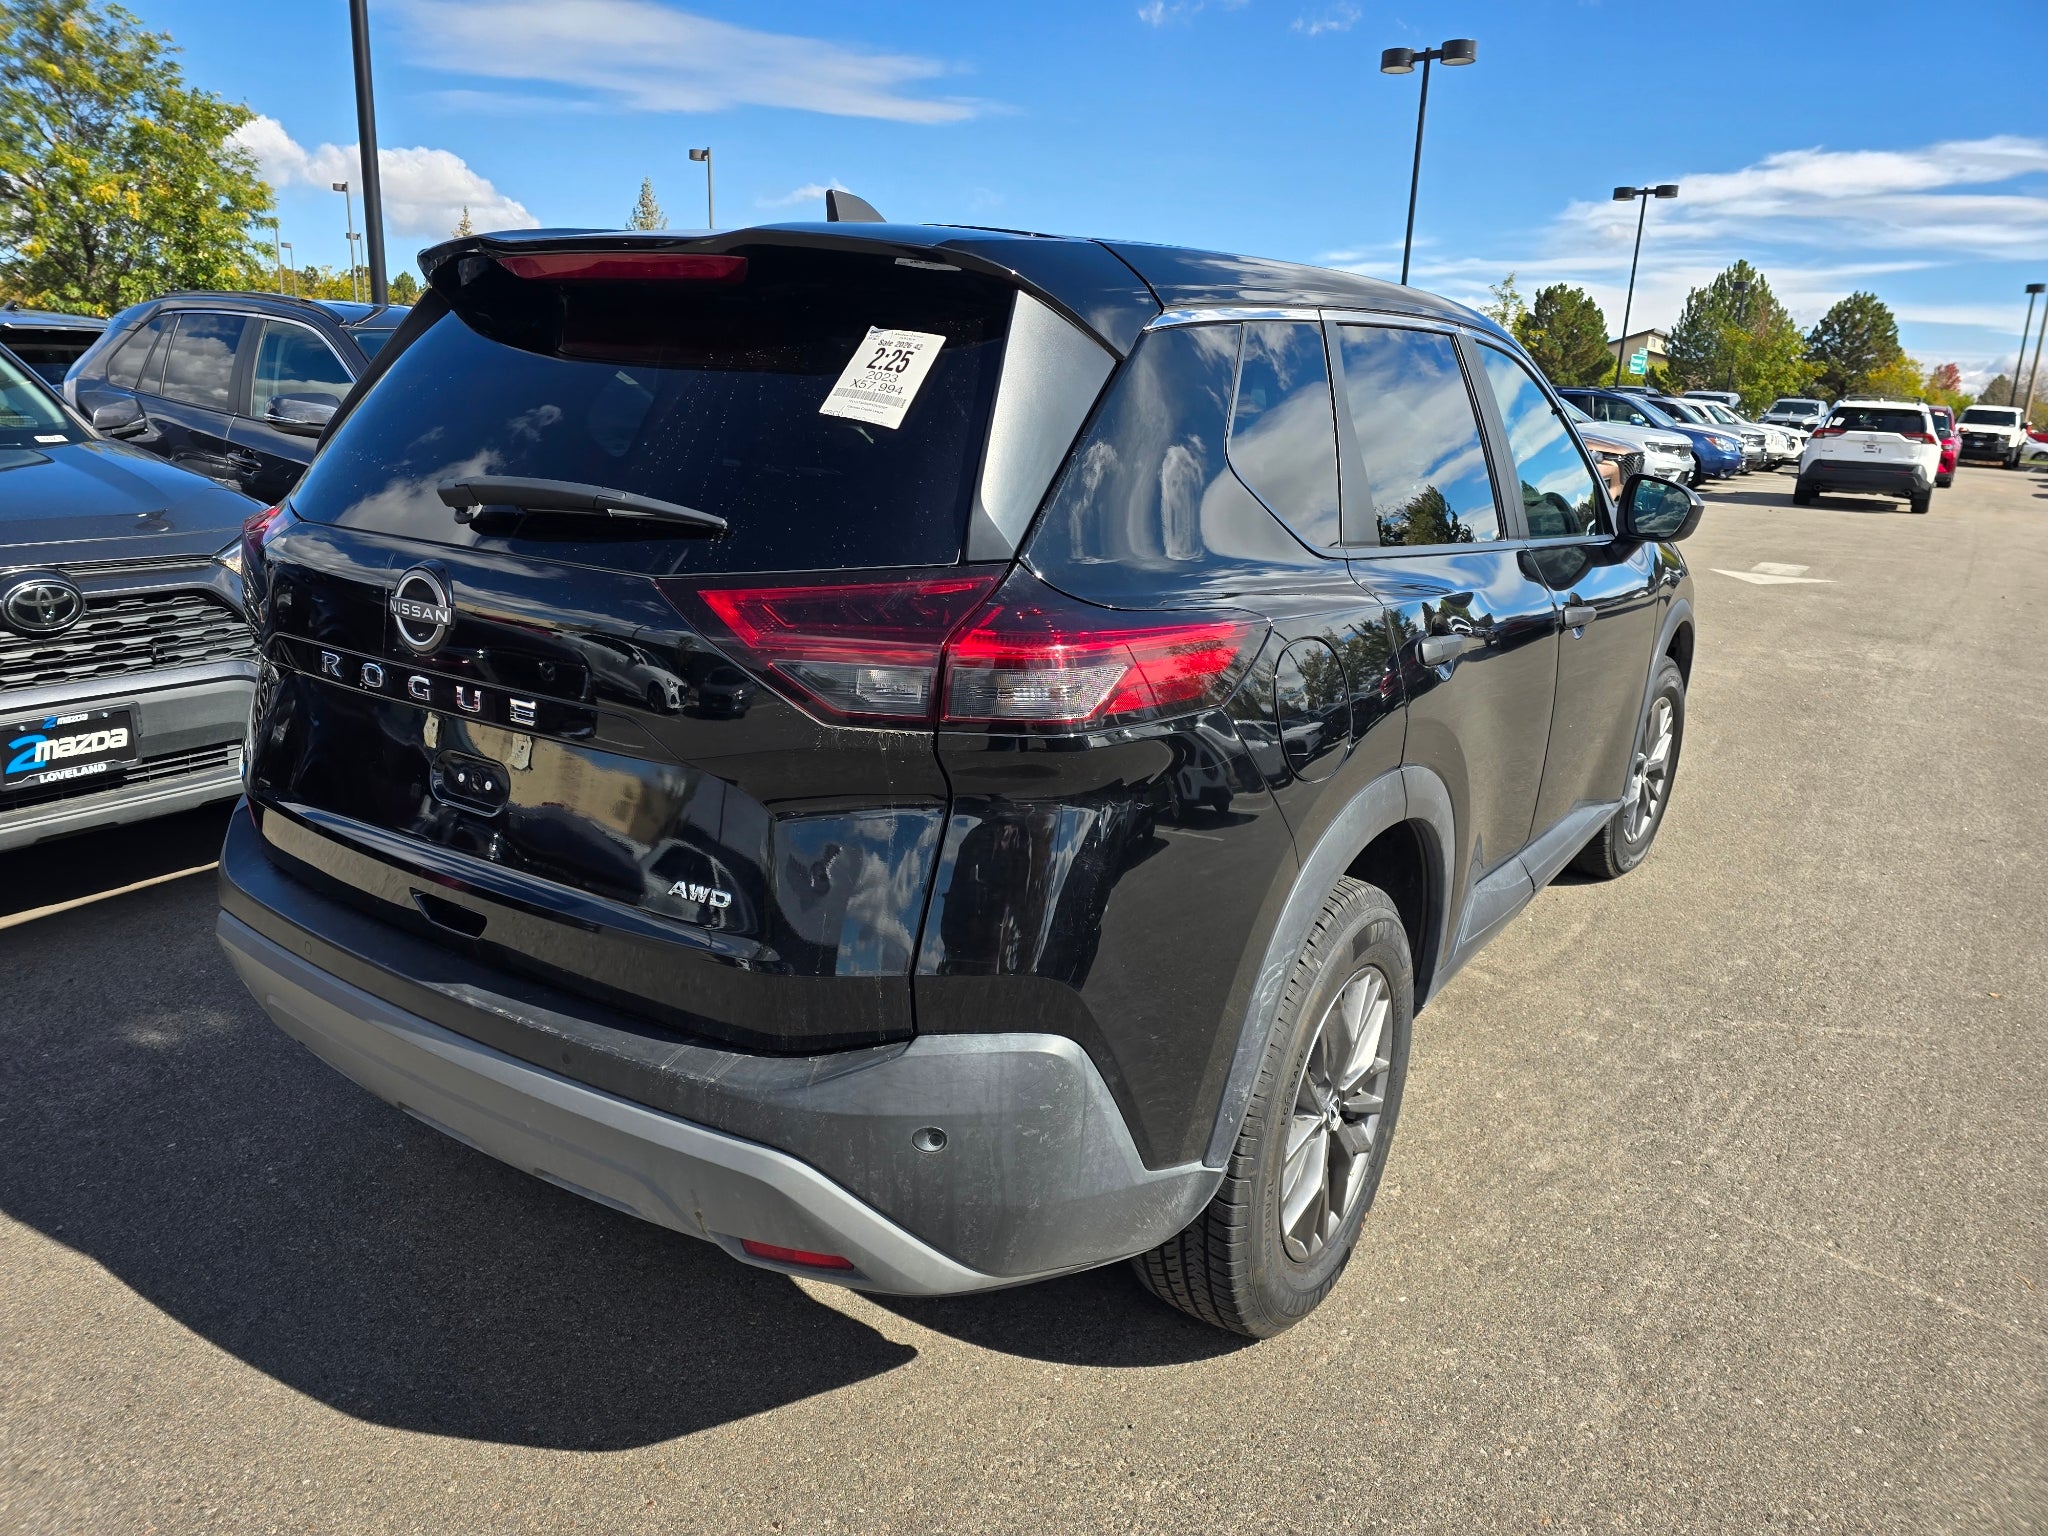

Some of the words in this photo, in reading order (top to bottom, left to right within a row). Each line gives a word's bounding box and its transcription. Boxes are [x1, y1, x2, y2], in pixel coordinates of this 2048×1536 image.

[877, 339, 894, 348] Sale
[866, 347, 915, 374] 2:25
[865, 370, 899, 383] 2023
[390, 599, 449, 624] NISSAN
[321, 650, 537, 727] ROGUE
[39, 762, 108, 783] LOVELAND
[667, 880, 732, 908] AWD
